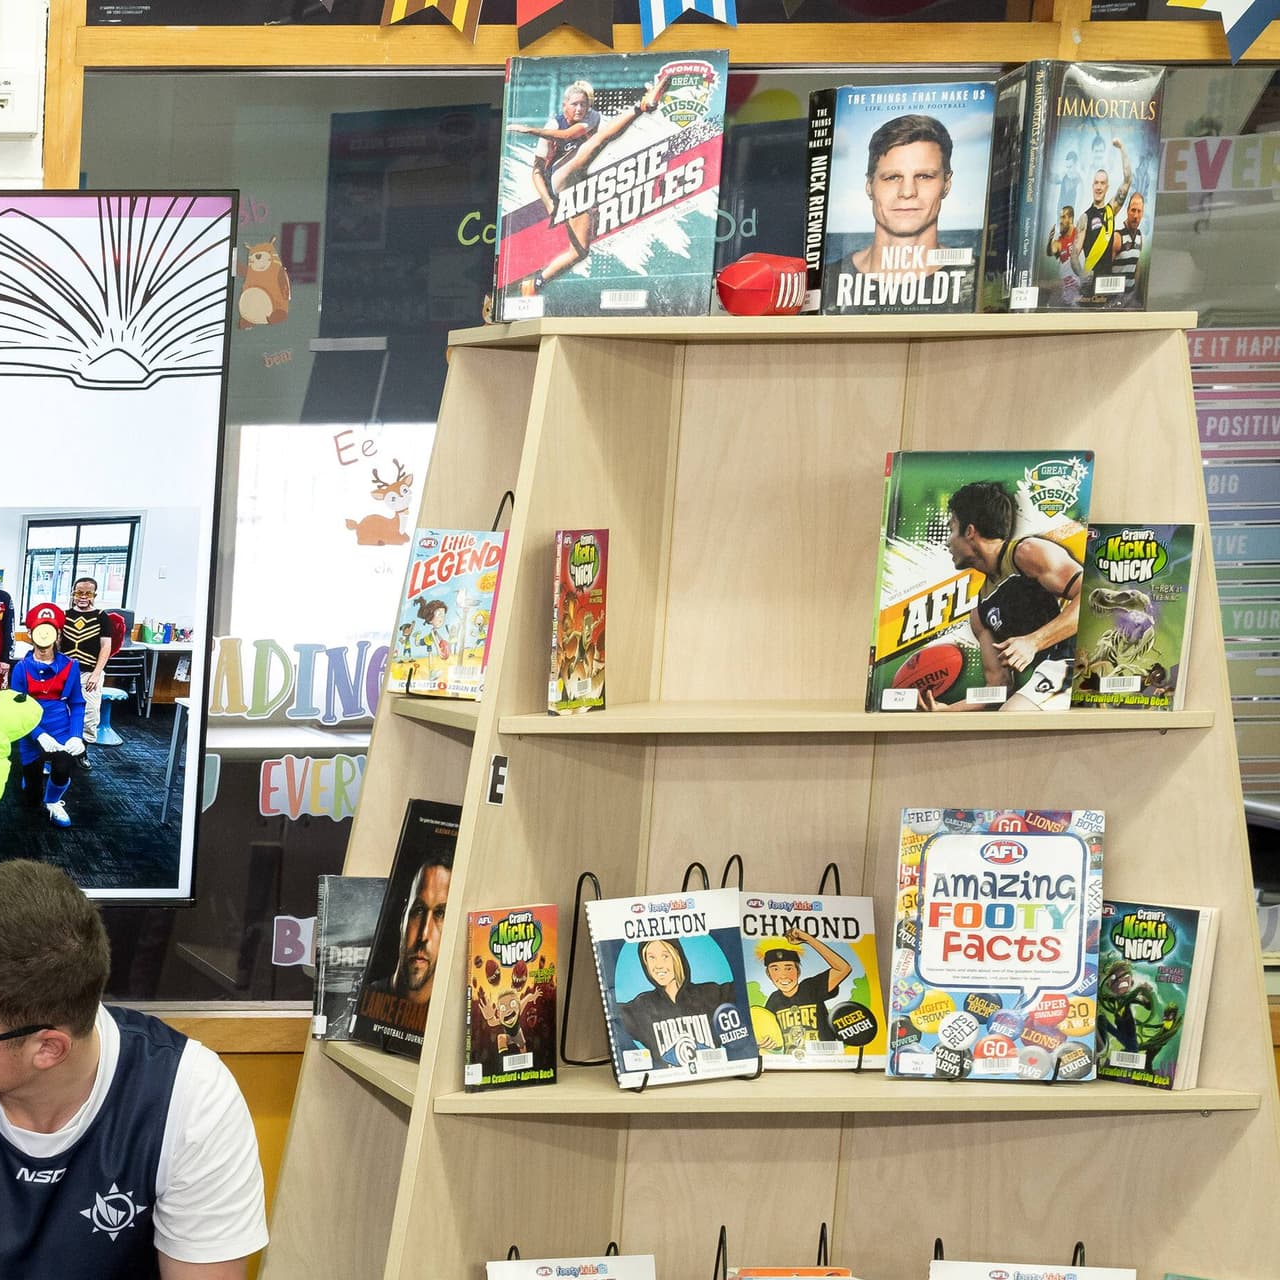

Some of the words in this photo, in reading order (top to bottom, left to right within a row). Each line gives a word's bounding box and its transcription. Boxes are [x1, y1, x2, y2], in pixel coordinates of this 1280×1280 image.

[666, 63, 710, 76] WOMEN
[671, 77, 700, 86] GREAT
[848, 94, 866, 105] THE
[870, 93, 907, 104] THINGS
[912, 91, 937, 102] THAT
[941, 91, 969, 102] MAKE
[973, 89, 986, 101] US
[927, 102, 967, 110] FOOTBALL
[660, 99, 711, 118] AUSSIE
[817, 108, 828, 117] THE
[1056, 96, 1157, 121] IMMORTALS
[811, 117, 832, 128] THINGS
[809, 139, 824, 149] MAKE
[825, 137, 832, 147] US
[814, 129, 828, 138] THAT
[810, 154, 828, 193] NICK
[552, 140, 670, 227] AUSSIE
[596, 156, 705, 237] RULES
[806, 193, 826, 270] RIEWOLDT
[881, 245, 926, 270] NICK
[836, 271, 967, 307] RIEWOLDT
[1212, 336, 1230, 358] IT
[333, 429, 378, 466] Ee
[1041, 466, 1068, 475] GREAT
[1208, 474, 1240, 494] BIG
[1031, 488, 1077, 507] AUSSIE
[1039, 503, 1065, 511] SPORTS
[441, 535, 475, 553] Little
[1098, 559, 1109, 570] to
[902, 574, 980, 643] AFL
[210, 637, 390, 723] ADING
[908, 809, 940, 825] FREO
[998, 819, 1022, 833] GO
[1025, 811, 1067, 833] LIONS!
[1083, 810, 1105, 824] ROO
[983, 845, 1025, 859] AFL
[929, 902, 1078, 930] FOOTY
[624, 913, 707, 940] CARLTON
[743, 914, 860, 940] CHMOND
[1115, 935, 1126, 946] to
[1036, 1000, 1068, 1011] UPER
[1067, 1003, 1090, 1019] GO
[718, 1009, 741, 1031] GO
[833, 1010, 866, 1029] TIGER
[942, 1014, 969, 1040] CATS
[990, 1022, 1016, 1036] RULE
[719, 1027, 749, 1046] BLUES!
[838, 1019, 874, 1041] TOUGH
[950, 1022, 978, 1049] RULE
[1021, 1027, 1063, 1050] LIONS!
[891, 1034, 919, 1049] POWER
[983, 1041, 1008, 1057] GO
[1060, 1055, 1091, 1075] TOUGH
[15, 1167, 68, 1184] NSD
